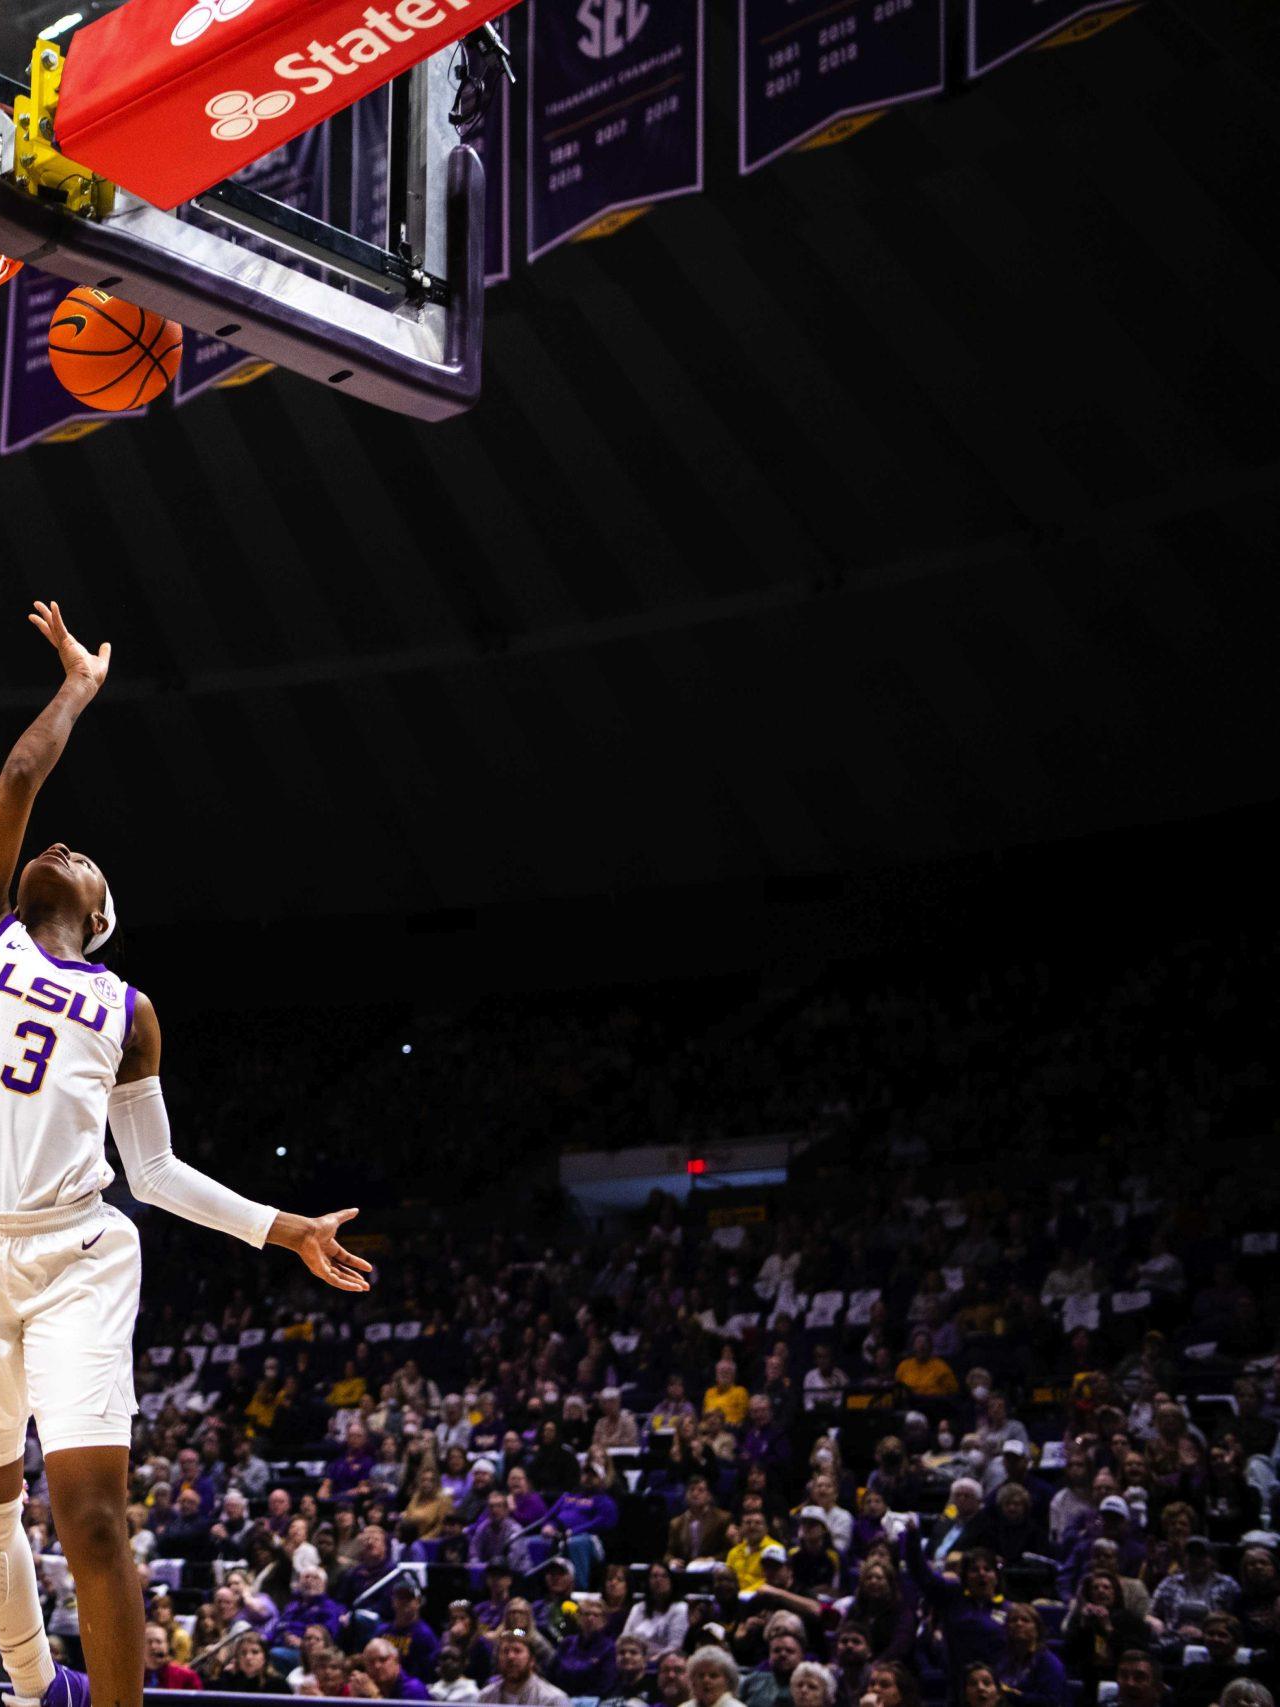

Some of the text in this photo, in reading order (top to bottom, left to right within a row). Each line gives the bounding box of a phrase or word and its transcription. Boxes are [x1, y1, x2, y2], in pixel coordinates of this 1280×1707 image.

[274, 0, 473, 95] State
[576, 0, 650, 60] SEC
[1, 1019, 60, 1097] 3
